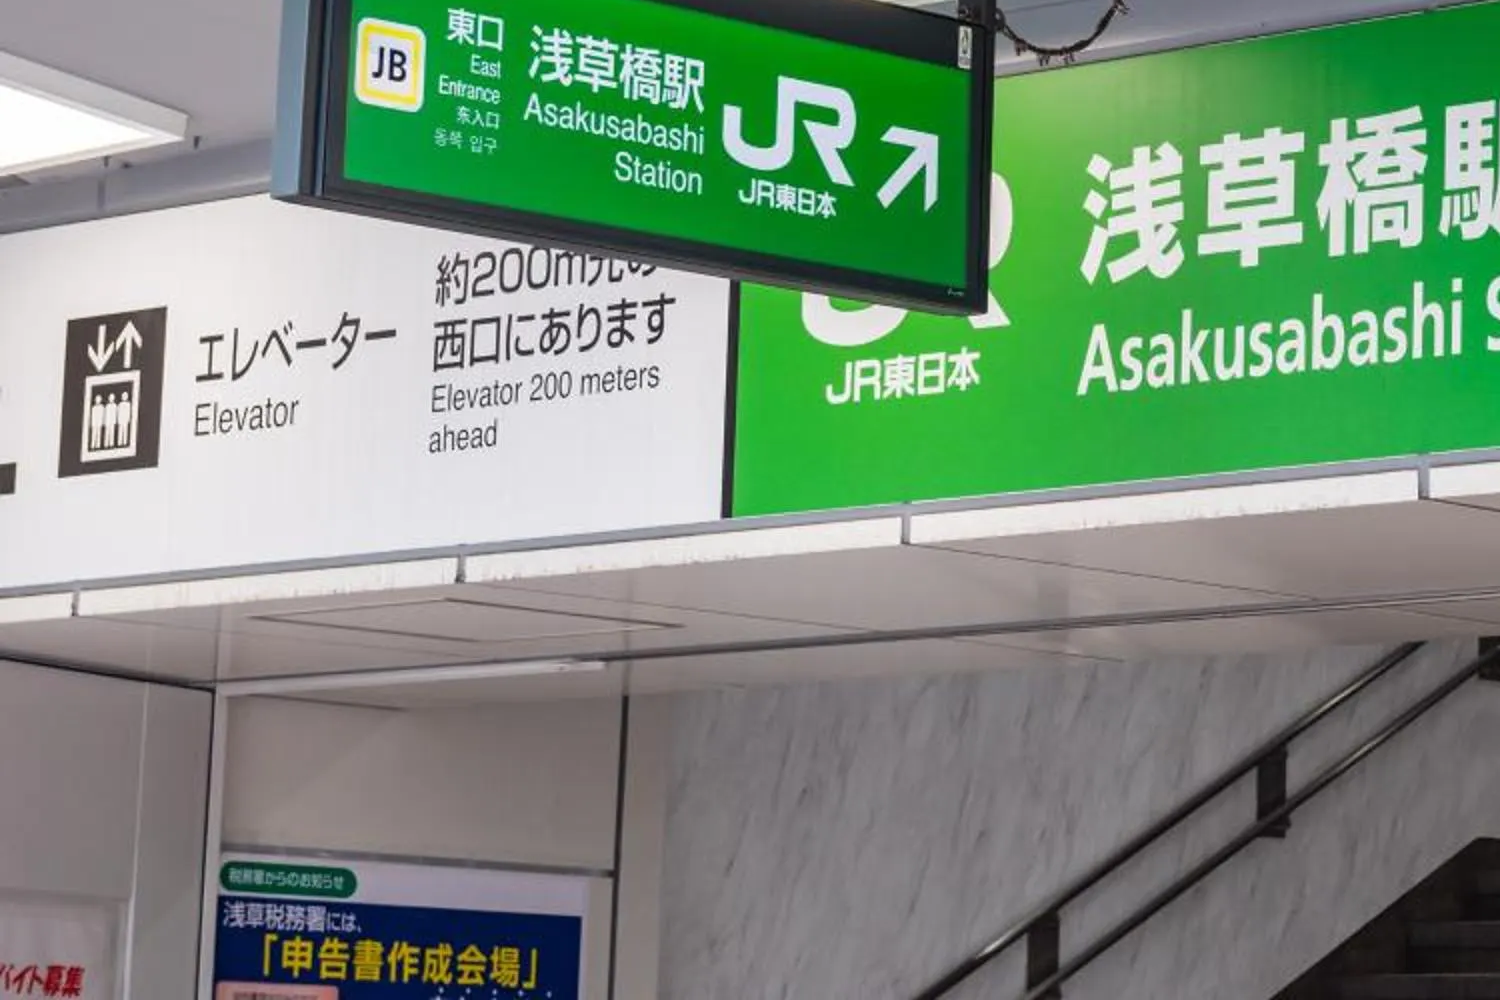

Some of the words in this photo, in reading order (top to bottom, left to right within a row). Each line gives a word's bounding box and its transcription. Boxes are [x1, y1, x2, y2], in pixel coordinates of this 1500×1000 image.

[447, 7, 504, 52] 東口
[371, 46, 407, 83] JB
[470, 54, 502, 80] East
[528, 24, 705, 113] 浅草橋駅
[438, 75, 501, 105] Entrance
[456, 106, 500, 130] 东入口
[523, 92, 705, 155] Asakusabashi
[722, 75, 857, 187] JR
[470, 134, 498, 155] 입구
[615, 151, 703, 196] Station
[738, 178, 838, 220] JR東日本
[434, 246, 657, 308] 約200m
[194, 311, 398, 383] エレベーター
[432, 292, 677, 373] 西口にあります
[1076, 279, 1464, 396] Asakusabashi
[431, 380, 524, 414] Elevator
[529, 370, 573, 403] 200
[579, 363, 660, 396] meters
[825, 346, 981, 406] JR東日本
[193, 395, 300, 437] Elevator
[428, 419, 498, 455] ahead
[263, 932, 539, 989] 「申告書作成会場」
